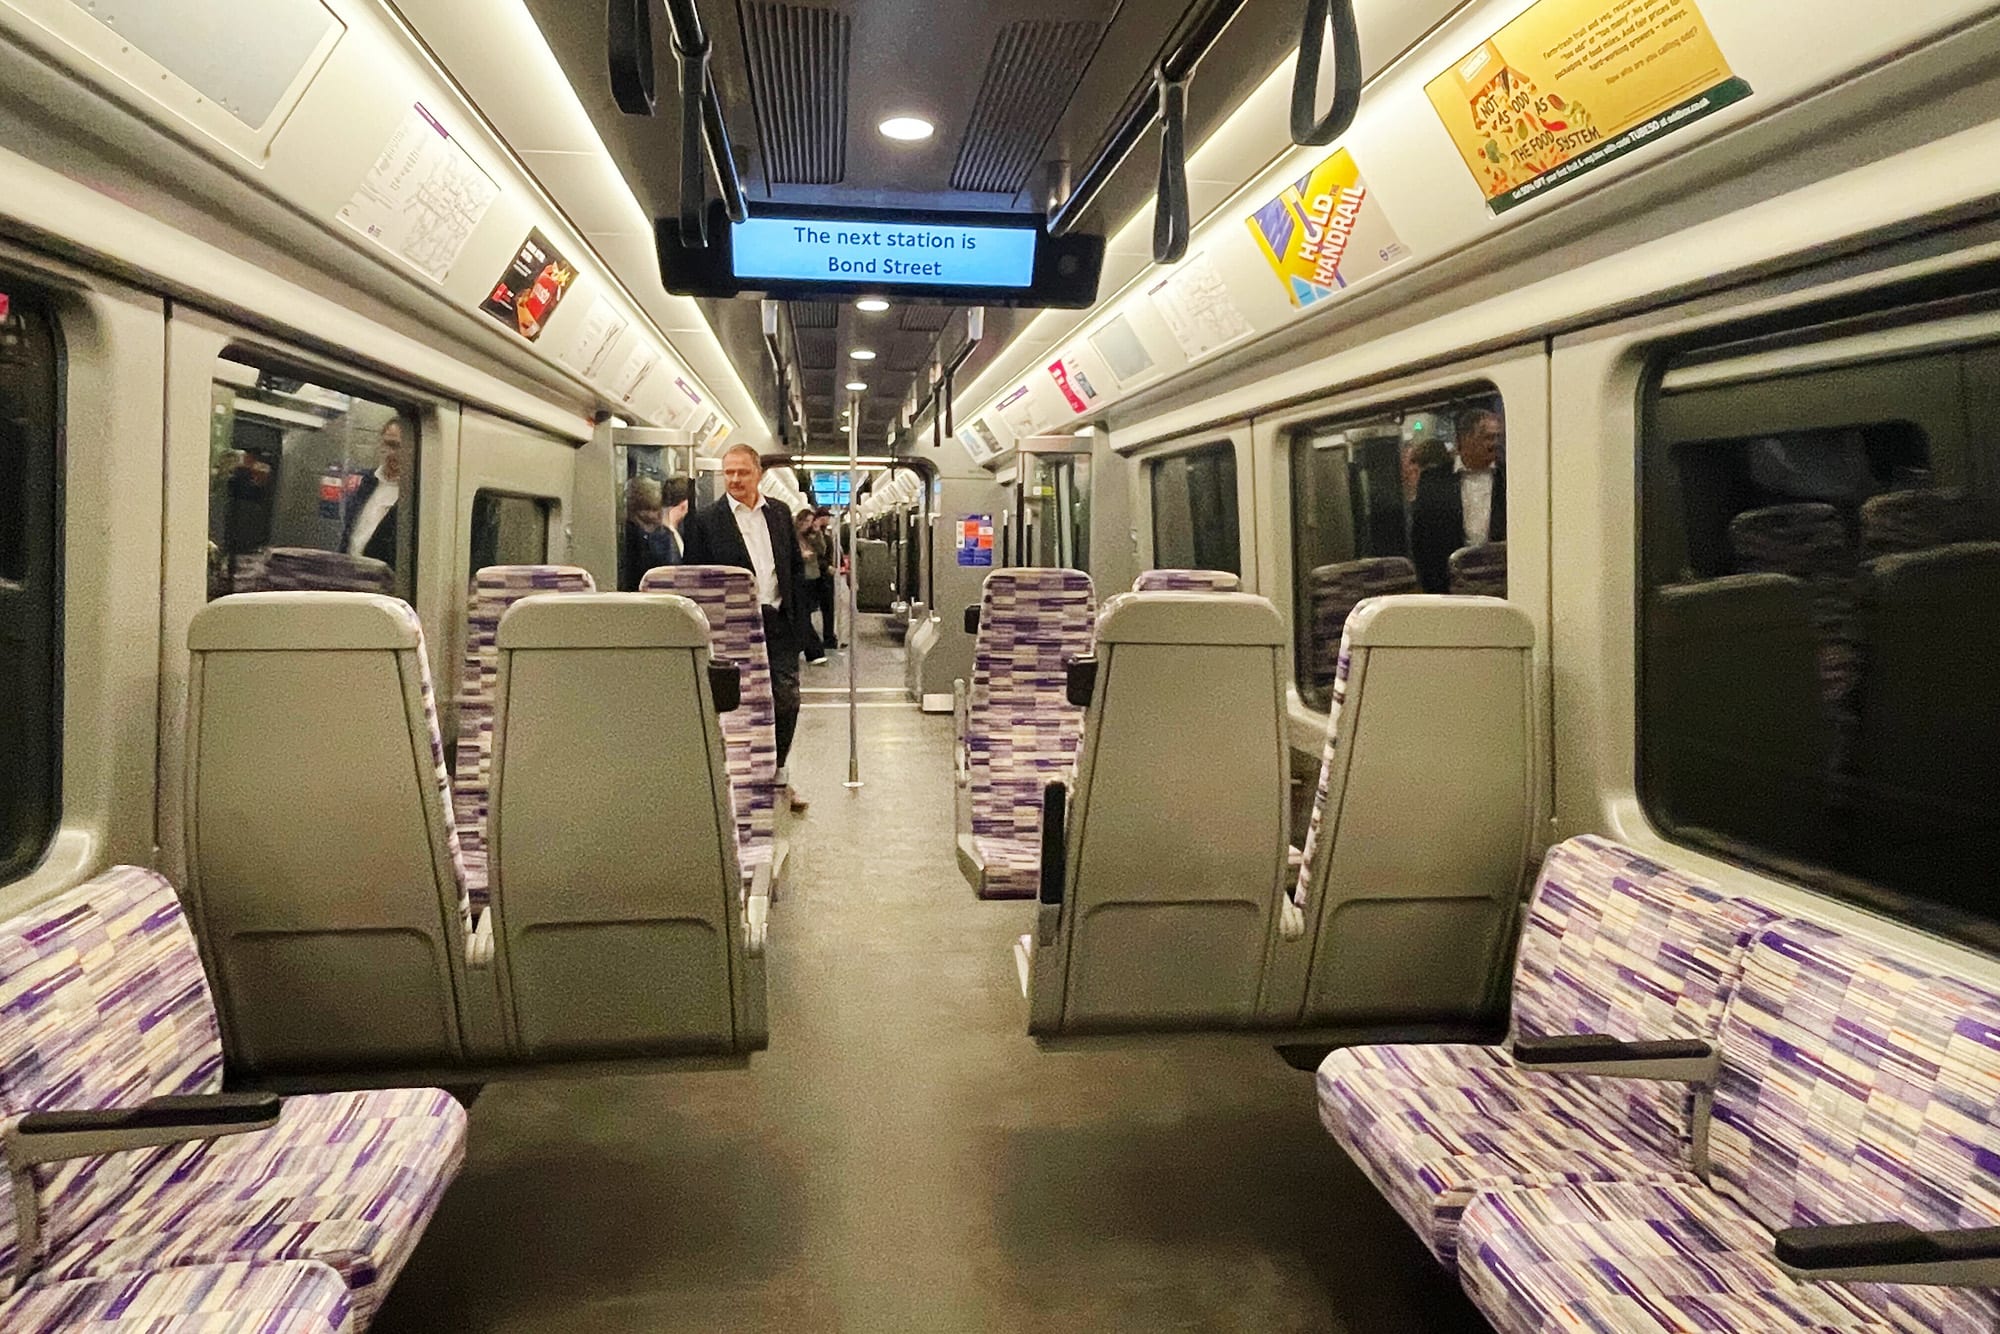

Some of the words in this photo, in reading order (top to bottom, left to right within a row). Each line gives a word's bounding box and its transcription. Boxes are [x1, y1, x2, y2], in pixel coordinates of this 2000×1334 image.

[1588, 19, 1599, 31] and
[1588, 45, 1603, 57] food
[1622, 24, 1635, 37] And
[1635, 17, 1647, 28] fair
[1648, 4, 1670, 22] prices
[1480, 94, 1499, 119] NOT
[1498, 111, 1510, 125] AS
[1512, 92, 1530, 113] ODD
[1535, 97, 1549, 116] AS
[1511, 142, 1531, 162] THE
[1530, 130, 1555, 153] FOOD
[794, 227, 830, 244] The
[837, 230, 881, 246] next
[887, 232, 955, 249] station
[961, 233, 976, 249] is
[1298, 194, 1335, 262] HOLD
[1313, 185, 1367, 286] HANDRAIL
[828, 257, 877, 274] Bond
[883, 258, 942, 276] Street
